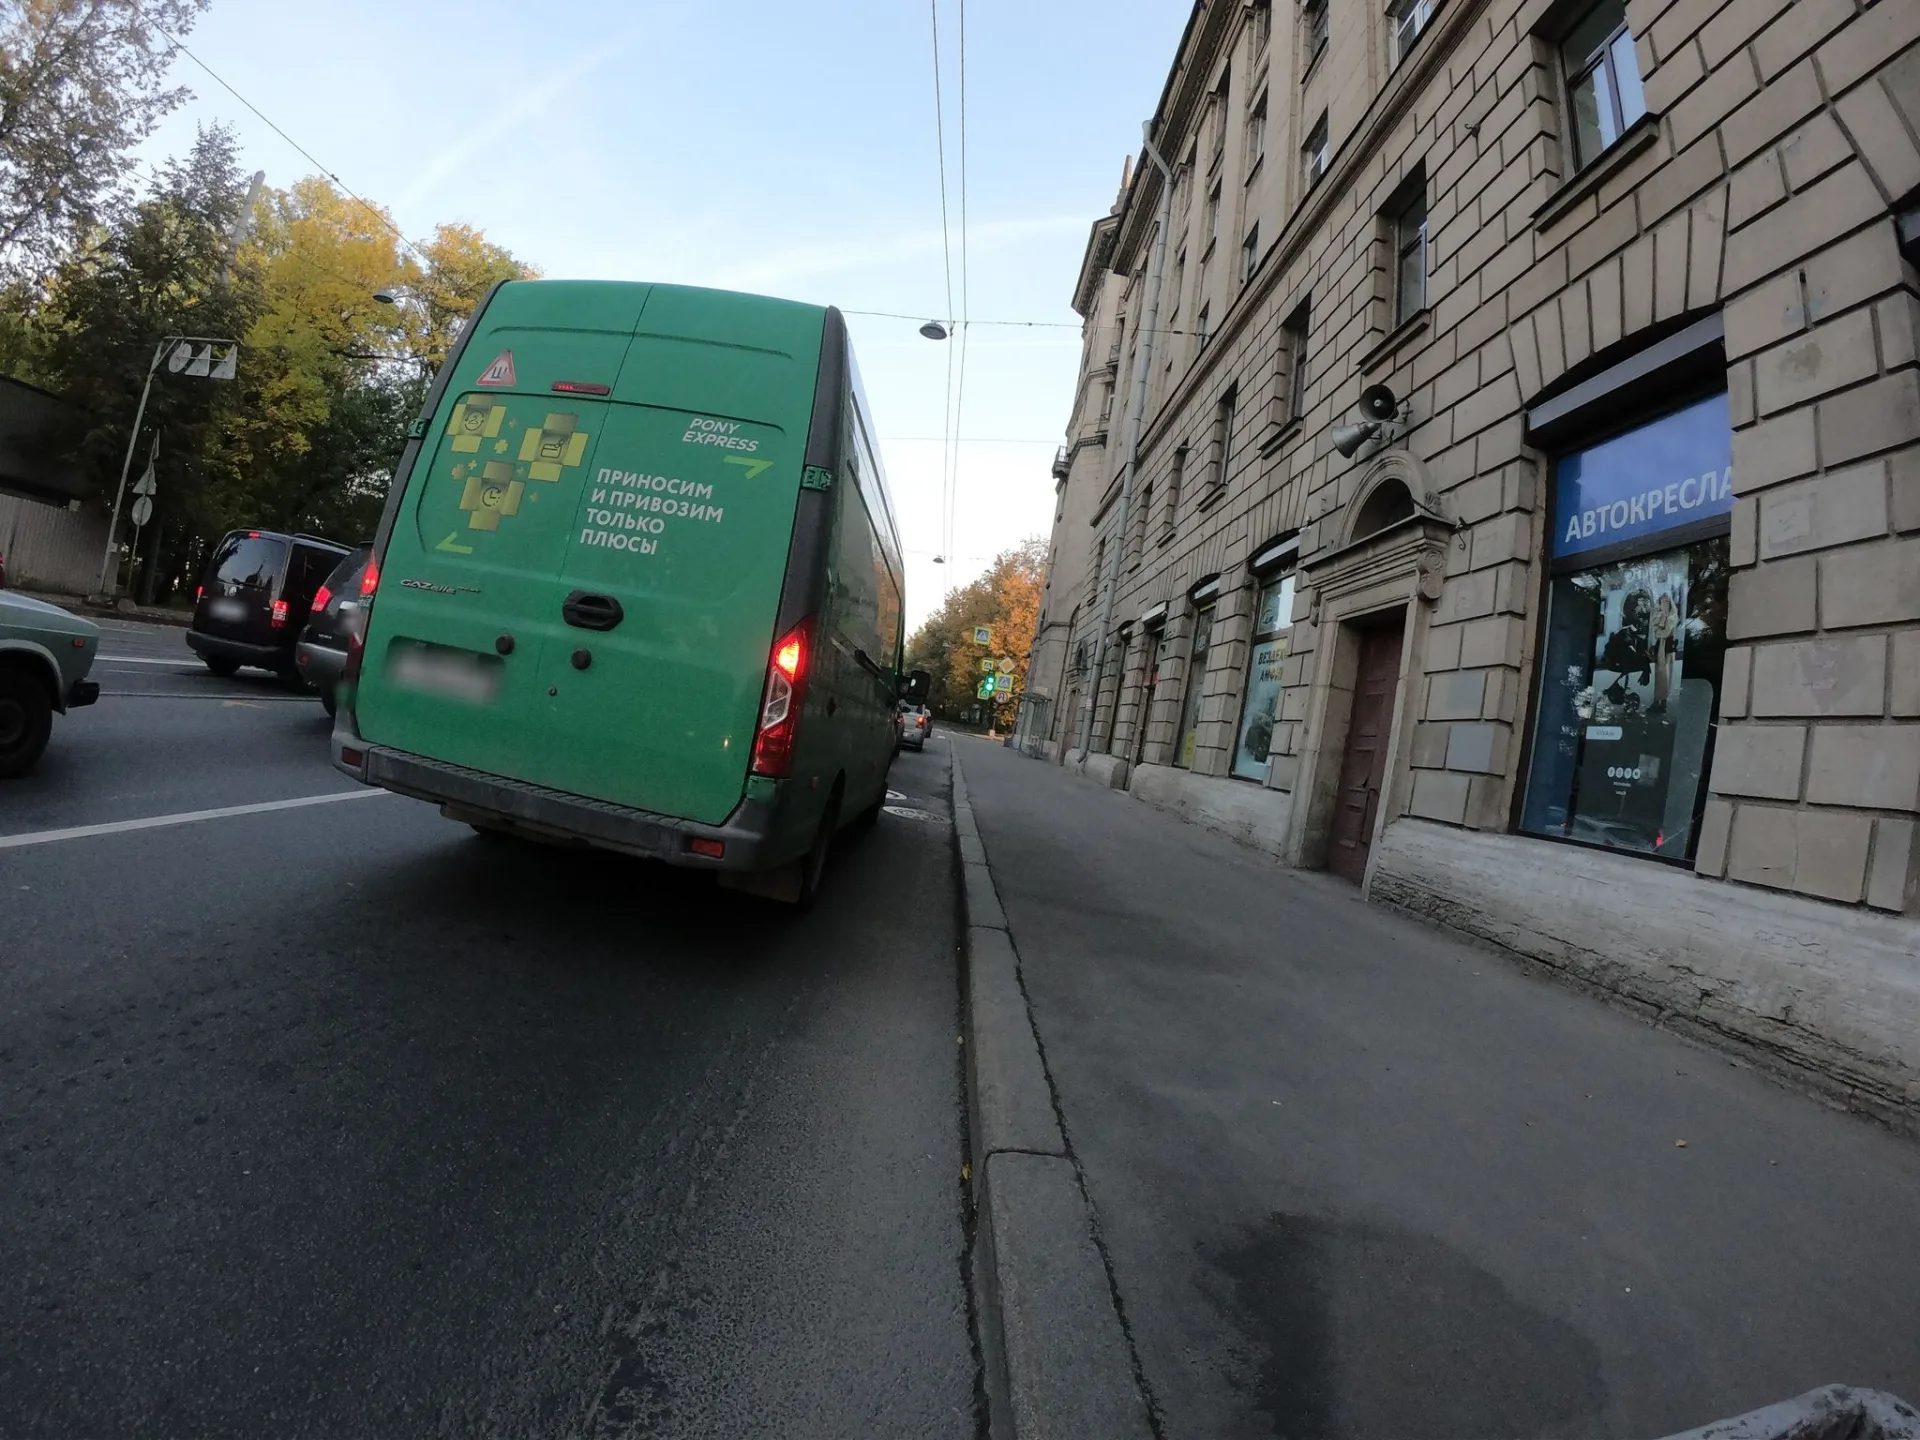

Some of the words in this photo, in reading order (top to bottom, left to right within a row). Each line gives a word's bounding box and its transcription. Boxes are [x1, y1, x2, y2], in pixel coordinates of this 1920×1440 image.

[690, 418, 740, 434] PONY
[682, 431, 759, 452] EXPRESS
[596, 468, 713, 500] ПРИНОСИМ
[591, 488, 607, 504] И
[609, 491, 724, 523] ПРИВОЗИМ
[587, 508, 665, 534] ТОЛЬКО
[580, 528, 658, 555] ПЛЮСЫ
